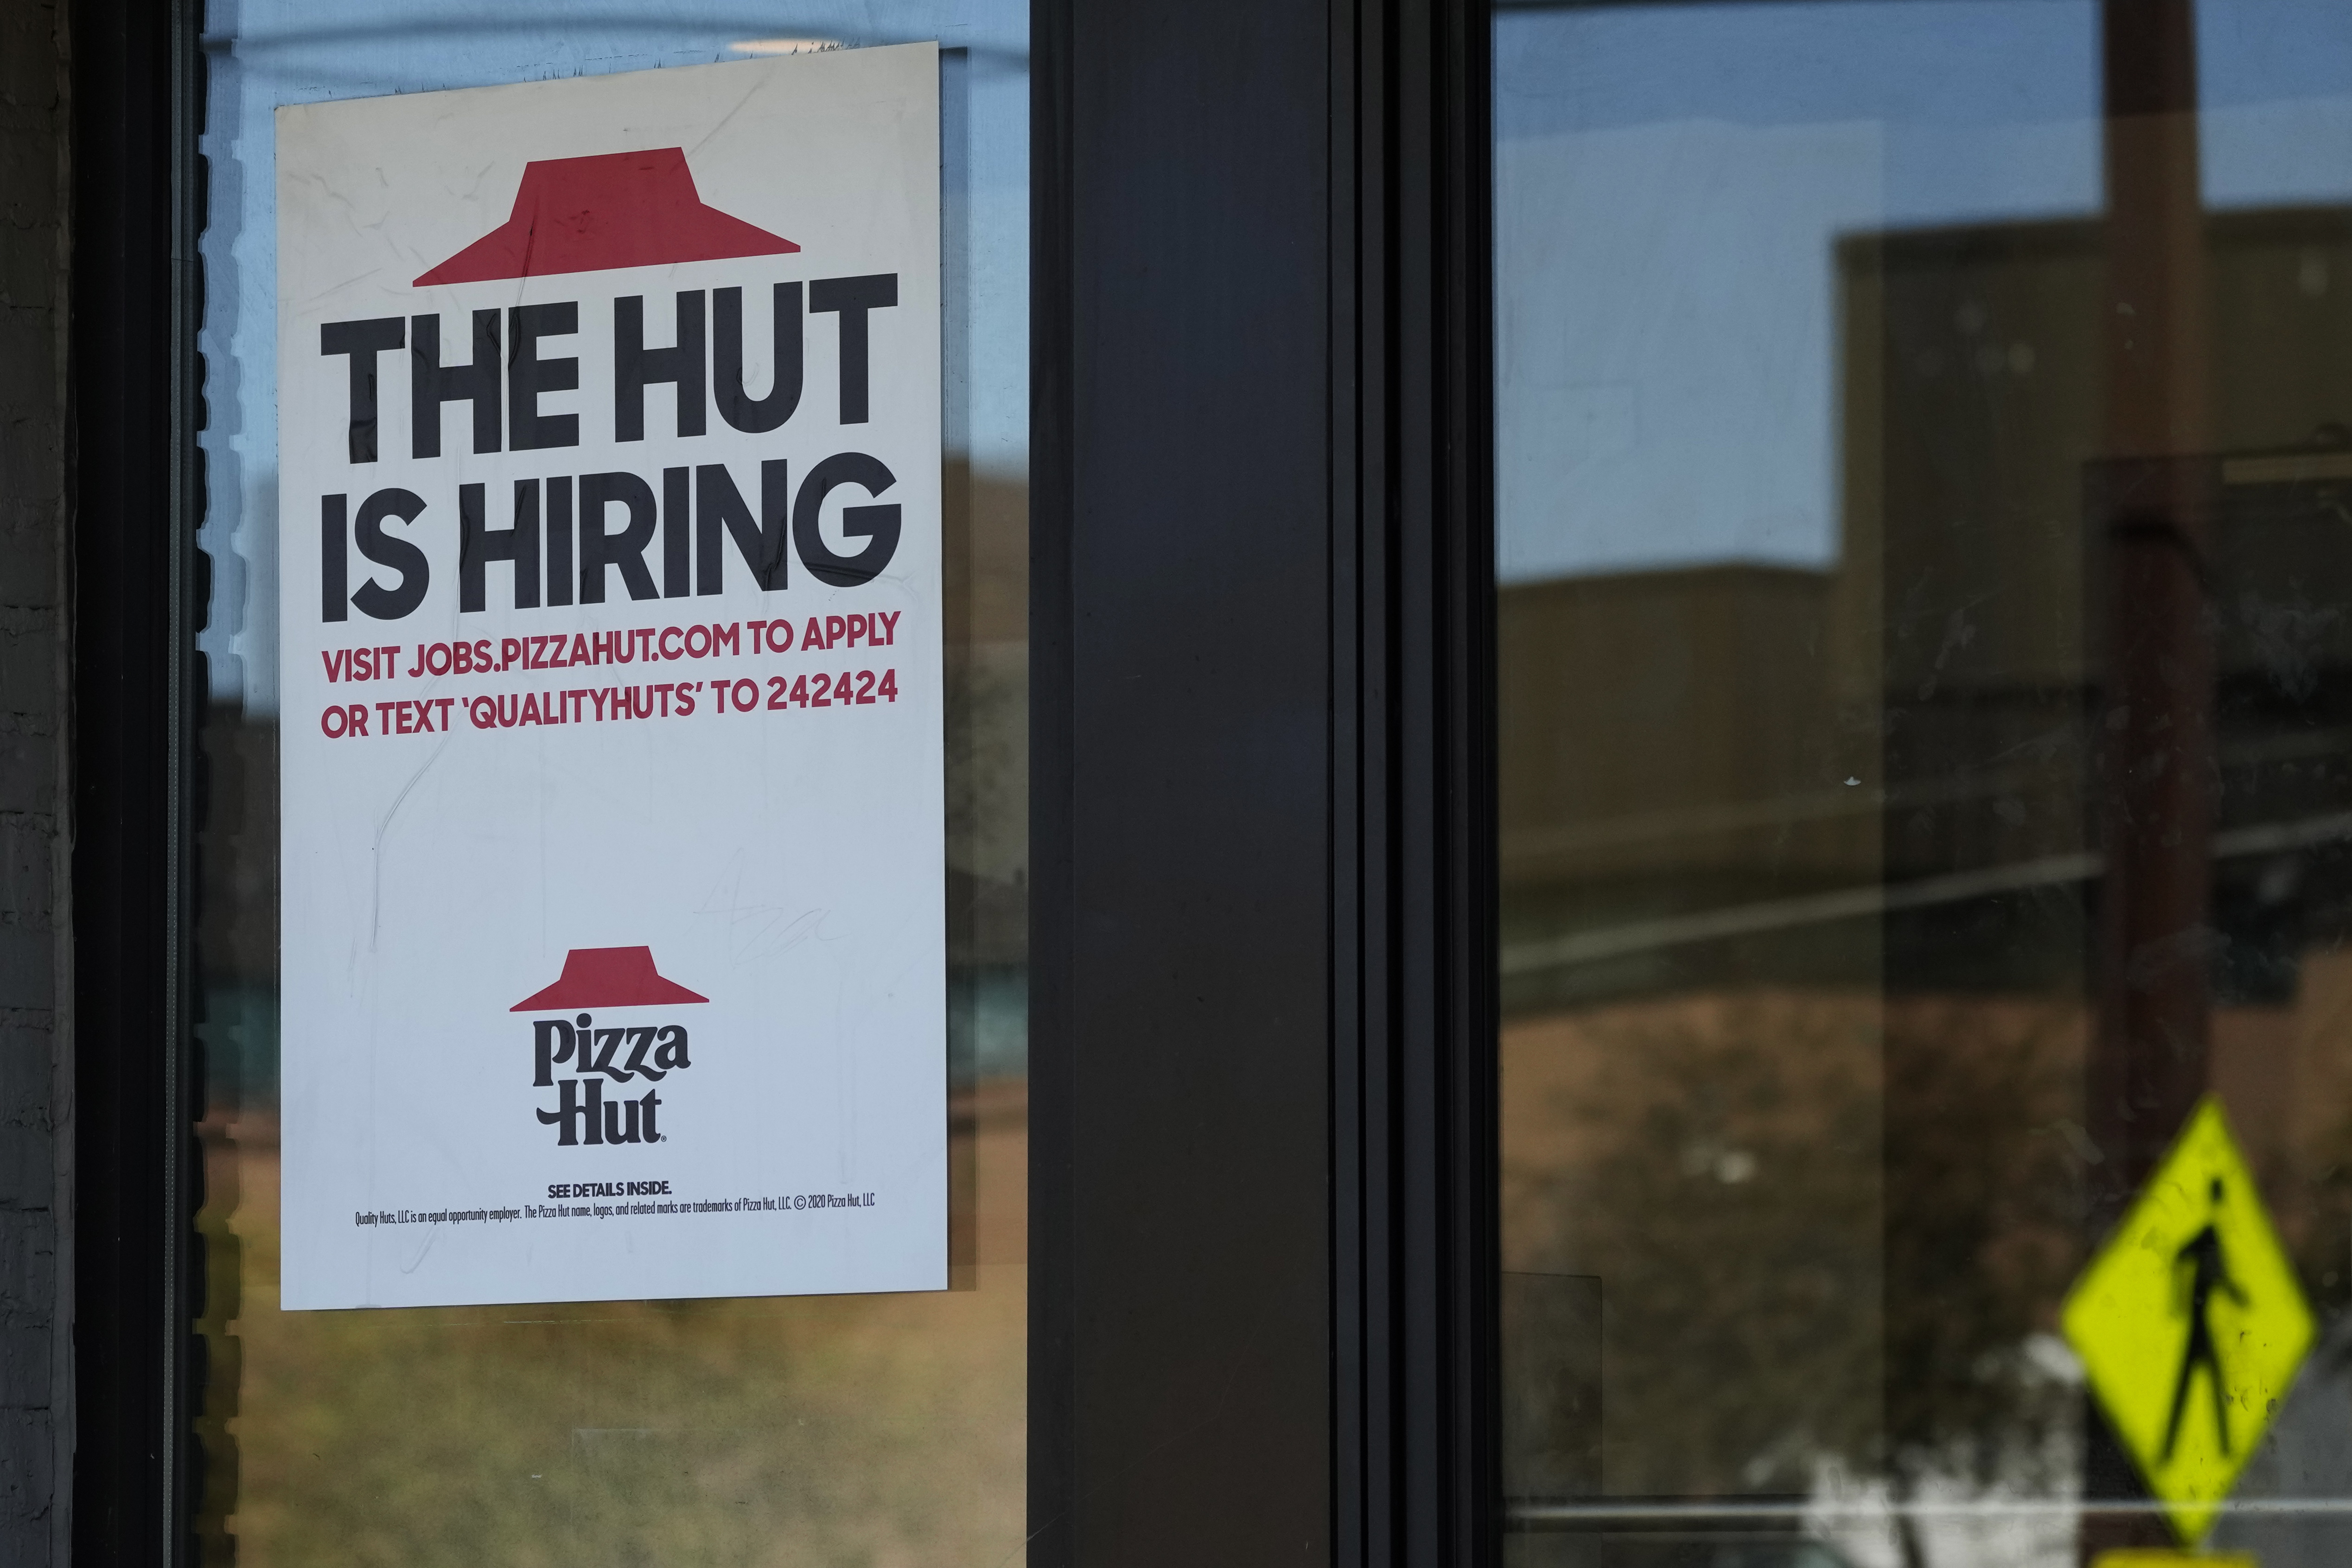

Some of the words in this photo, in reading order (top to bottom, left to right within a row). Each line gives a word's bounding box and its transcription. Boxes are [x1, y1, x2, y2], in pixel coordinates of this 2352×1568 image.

[321, 301, 579, 464] THE
[614, 273, 898, 443] HUT
[322, 488, 429, 623] IS
[459, 452, 901, 612] HIRING
[322, 646, 400, 682] VISIT
[408, 622, 739, 677] JOBS.PIZZAHUT.COM
[747, 619, 794, 654] TO
[801, 611, 901, 651] APPLY
[321, 704, 369, 739] OR
[376, 698, 454, 735] TEXT
[711, 678, 759, 714] TO
[767, 669, 898, 710] 242424
[533, 1013, 691, 1086] Pizza
[356, 1211, 378, 1228] Quality
[380, 1211, 396, 1224] Huts,
[398, 1210, 409, 1223] LLC
[411, 1211, 416, 1223] is
[418, 1213, 427, 1223] an
[428, 1208, 447, 1225] equal
[449, 1208, 488, 1224] opportunity
[489, 1206, 522, 1223] employer.
[524, 1205, 536, 1218] The
[539, 1205, 556, 1218] Pizza
[558, 1204, 570, 1217] Hut
[572, 1207, 592, 1217] name,
[593, 1203, 614, 1219] logos,
[616, 1202, 629, 1215] and
[631, 1201, 655, 1215] related
[657, 1200, 678, 1214] marks
[680, 1204, 691, 1213] are
[693, 1198, 733, 1212] trademarks
[734, 1198, 741, 1211] of
[743, 1198, 761, 1211] Pizza
[763, 1197, 777, 1211] Hut,
[778, 1196, 791, 1210] LLC.
[808, 1194, 825, 1208] 2020
[828, 1194, 846, 1208] Pizza
[848, 1193, 861, 1208] Hut,
[863, 1192, 875, 1206] LLC
[548, 1184, 571, 1198] SEE
[573, 1182, 625, 1198] DETAILS
[626, 1180, 672, 1196] INSIDE.
